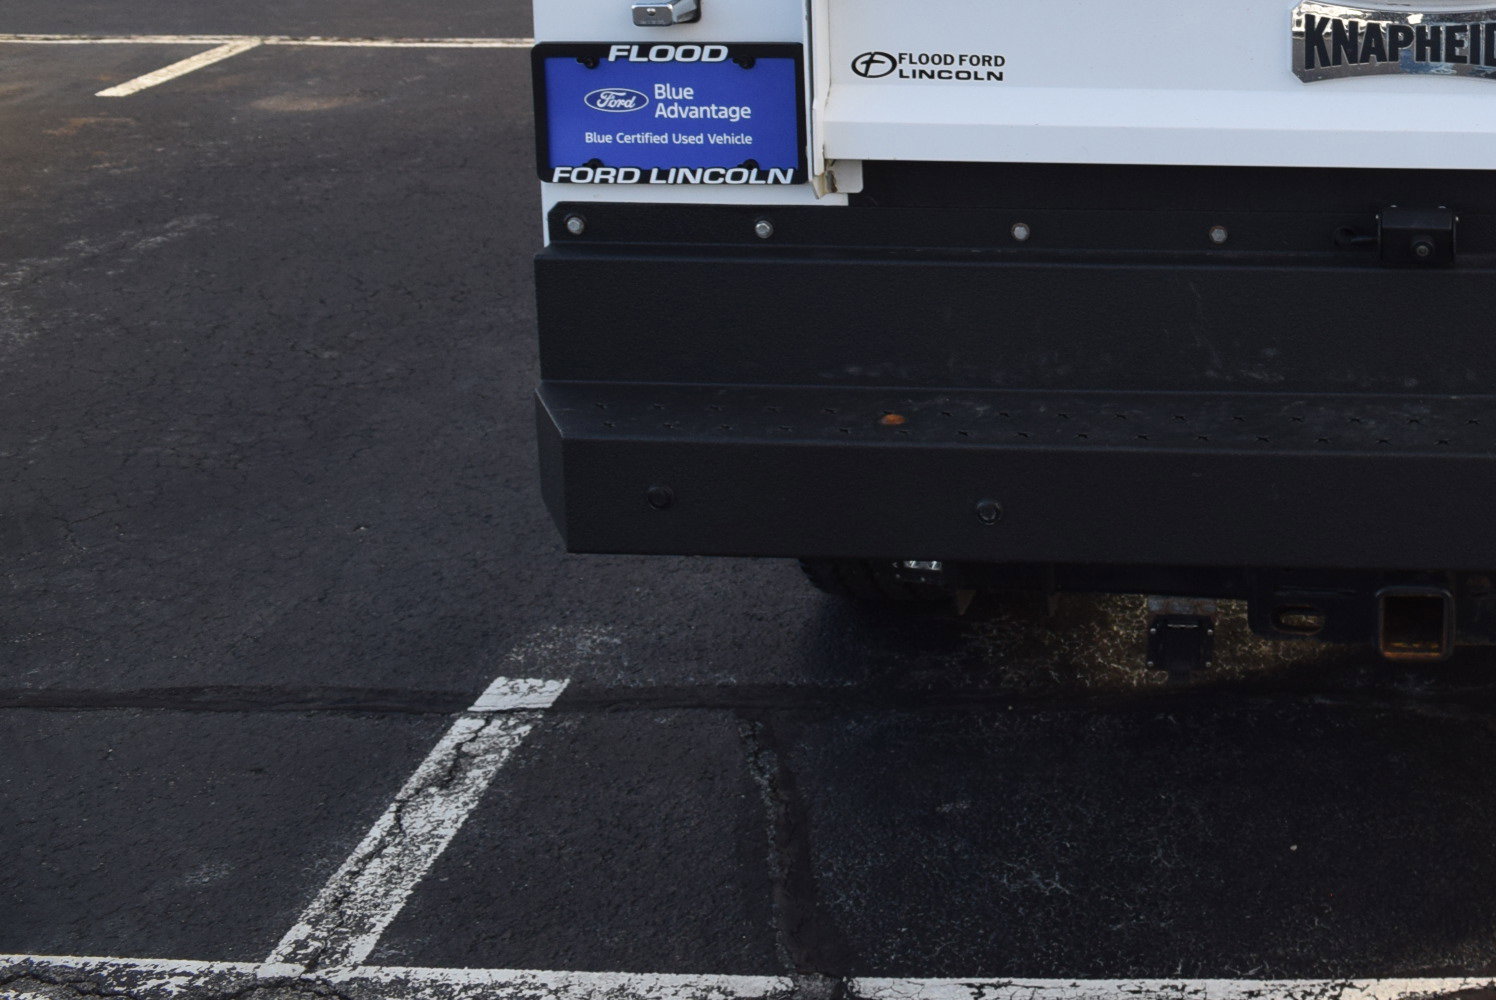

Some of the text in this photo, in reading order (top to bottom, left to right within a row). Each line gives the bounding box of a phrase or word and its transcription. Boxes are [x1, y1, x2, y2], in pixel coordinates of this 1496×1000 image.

[607, 44, 729, 62] FLOOD
[898, 52, 1006, 67] FLOOD FORD
[898, 68, 1004, 81] LINCOLN
[596, 91, 636, 109] Ford
[654, 83, 694, 100] Blue
[654, 102, 752, 122] Advantage
[585, 132, 753, 145] Blue Certified Used Vehicle
[552, 166, 795, 185] FORD LINCOLN
